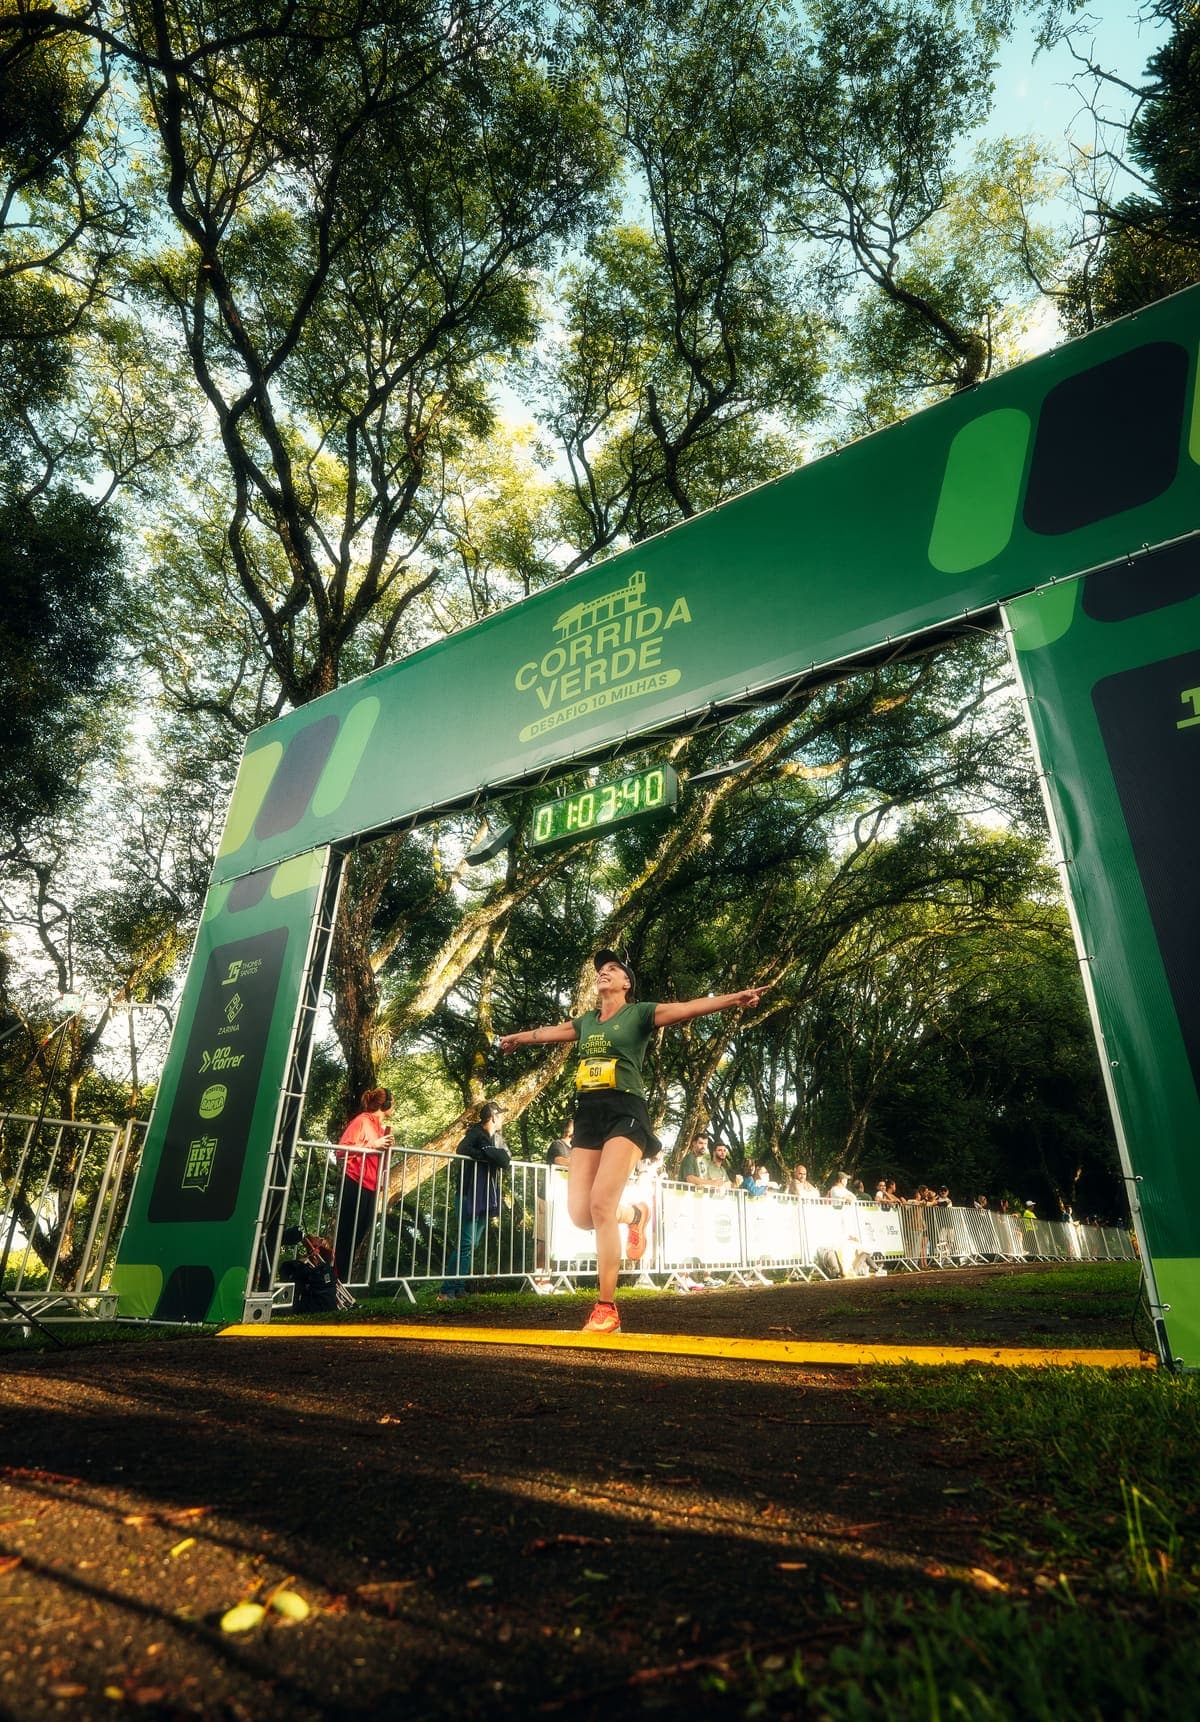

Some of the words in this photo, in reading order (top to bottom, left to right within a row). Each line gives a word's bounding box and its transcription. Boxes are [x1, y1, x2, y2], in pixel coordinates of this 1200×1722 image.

[515, 596, 692, 691] CORRIDA
[536, 636, 664, 710] VERDE
[530, 702, 588, 737] DESAFIO
[592, 694, 607, 709] 10
[610, 674, 667, 702] MILHAS
[217, 1024, 240, 1036] ZARINA
[581, 1040, 612, 1050] CORRIDA
[585, 1046, 607, 1056] VERDE
[212, 1046, 231, 1064] pro
[213, 1054, 245, 1070] correr
[190, 1147, 214, 1161] HEY
[186, 1160, 211, 1177] FIT
